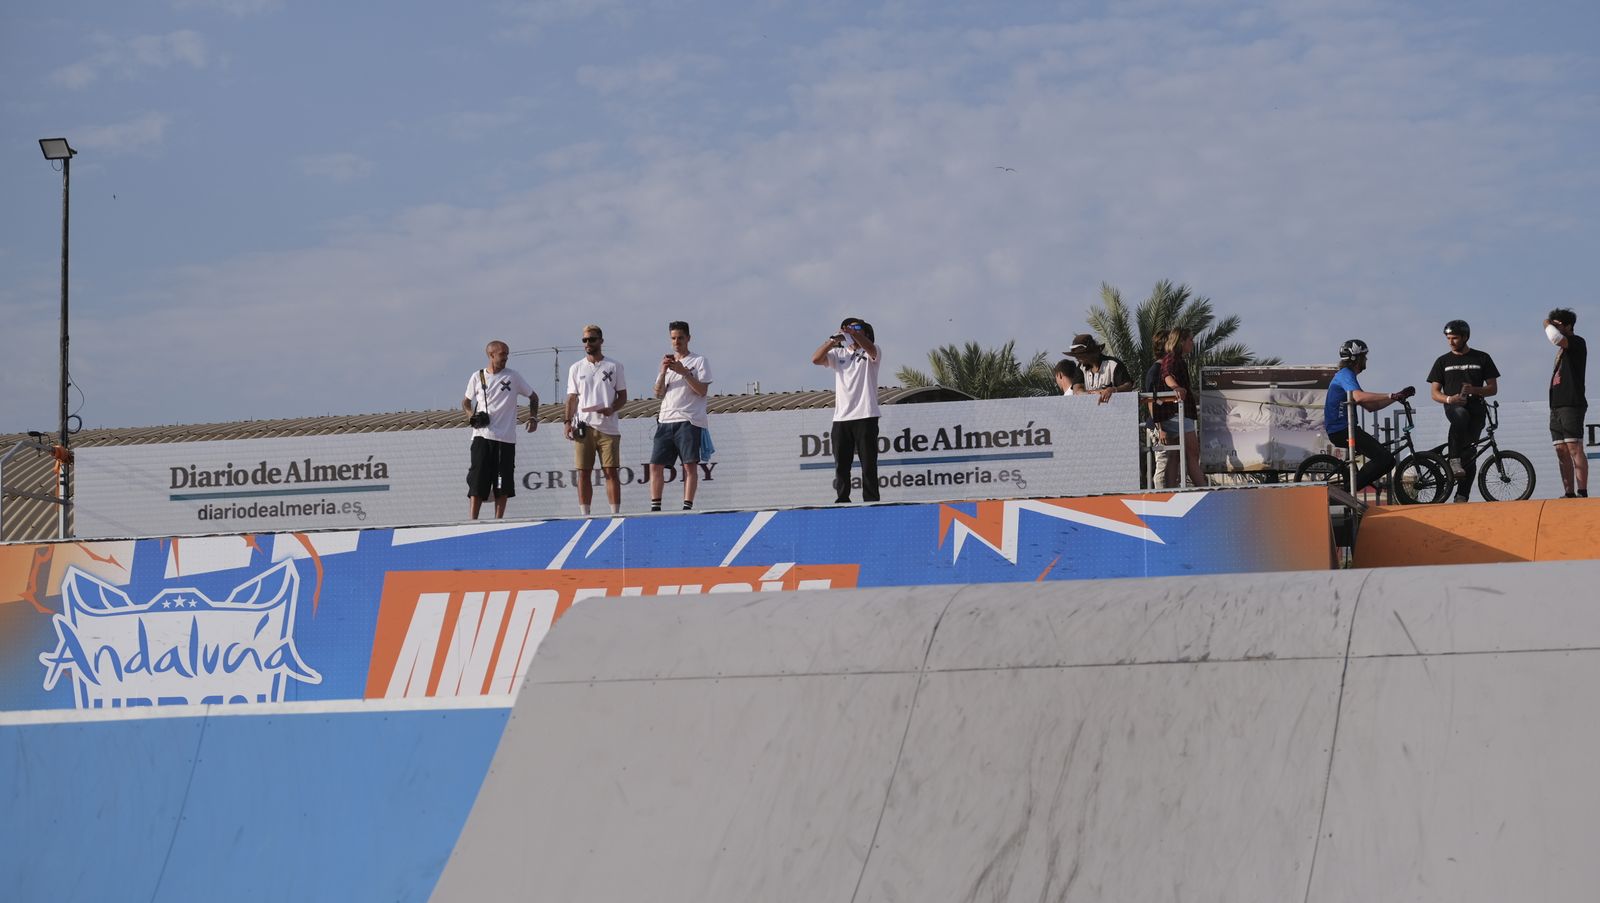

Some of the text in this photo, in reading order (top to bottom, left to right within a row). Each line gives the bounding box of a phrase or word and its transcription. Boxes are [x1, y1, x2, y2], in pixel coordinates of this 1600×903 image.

[893, 428, 928, 453] de
[931, 421, 1052, 451] Almería
[170, 455, 389, 489] Diario de Almería
[197, 499, 362, 520] diariodealmeria.es
[46, 613, 319, 685] Andalucía
